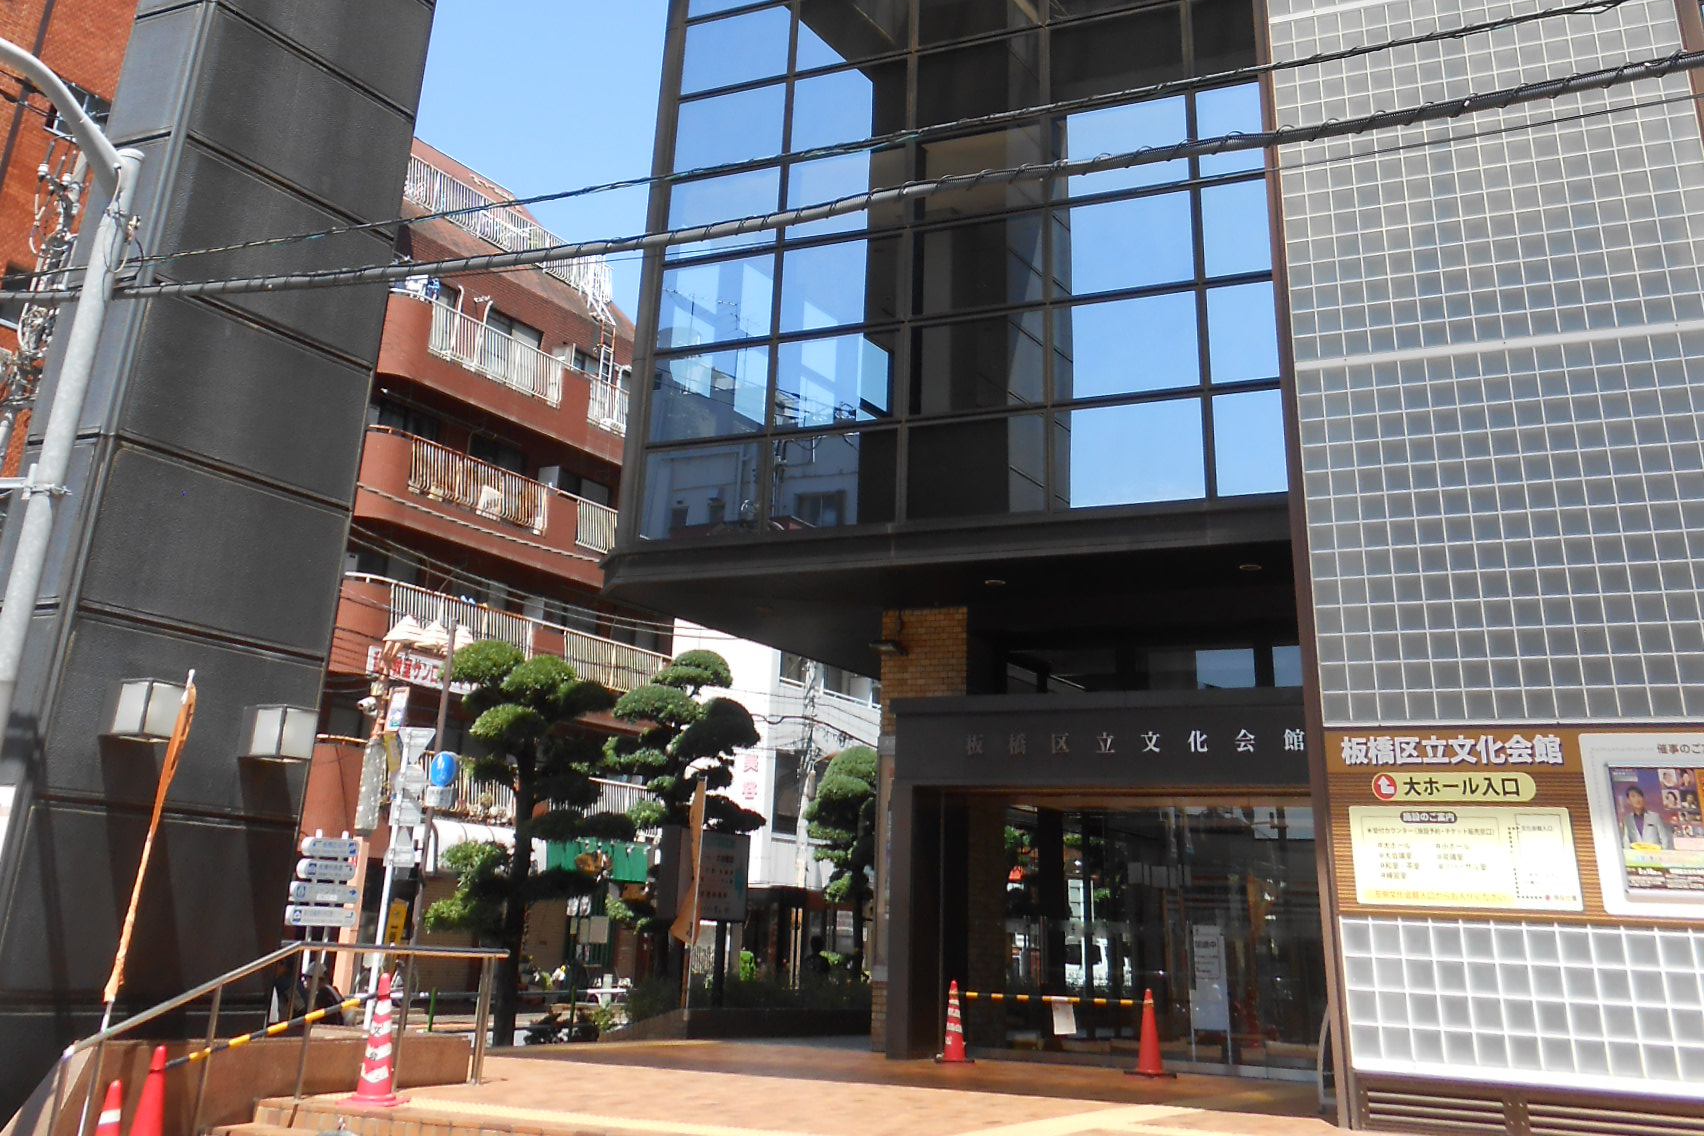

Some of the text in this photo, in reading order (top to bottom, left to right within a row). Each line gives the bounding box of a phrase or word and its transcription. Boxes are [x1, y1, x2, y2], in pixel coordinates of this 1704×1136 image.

[965, 728, 1306, 756] 板橋区立文化会館
[1341, 734, 1564, 765] 板橋区立文化会館
[1403, 776, 1521, 797] 大ホール入口
[1402, 812, 1456, 822] 施設のご案内
